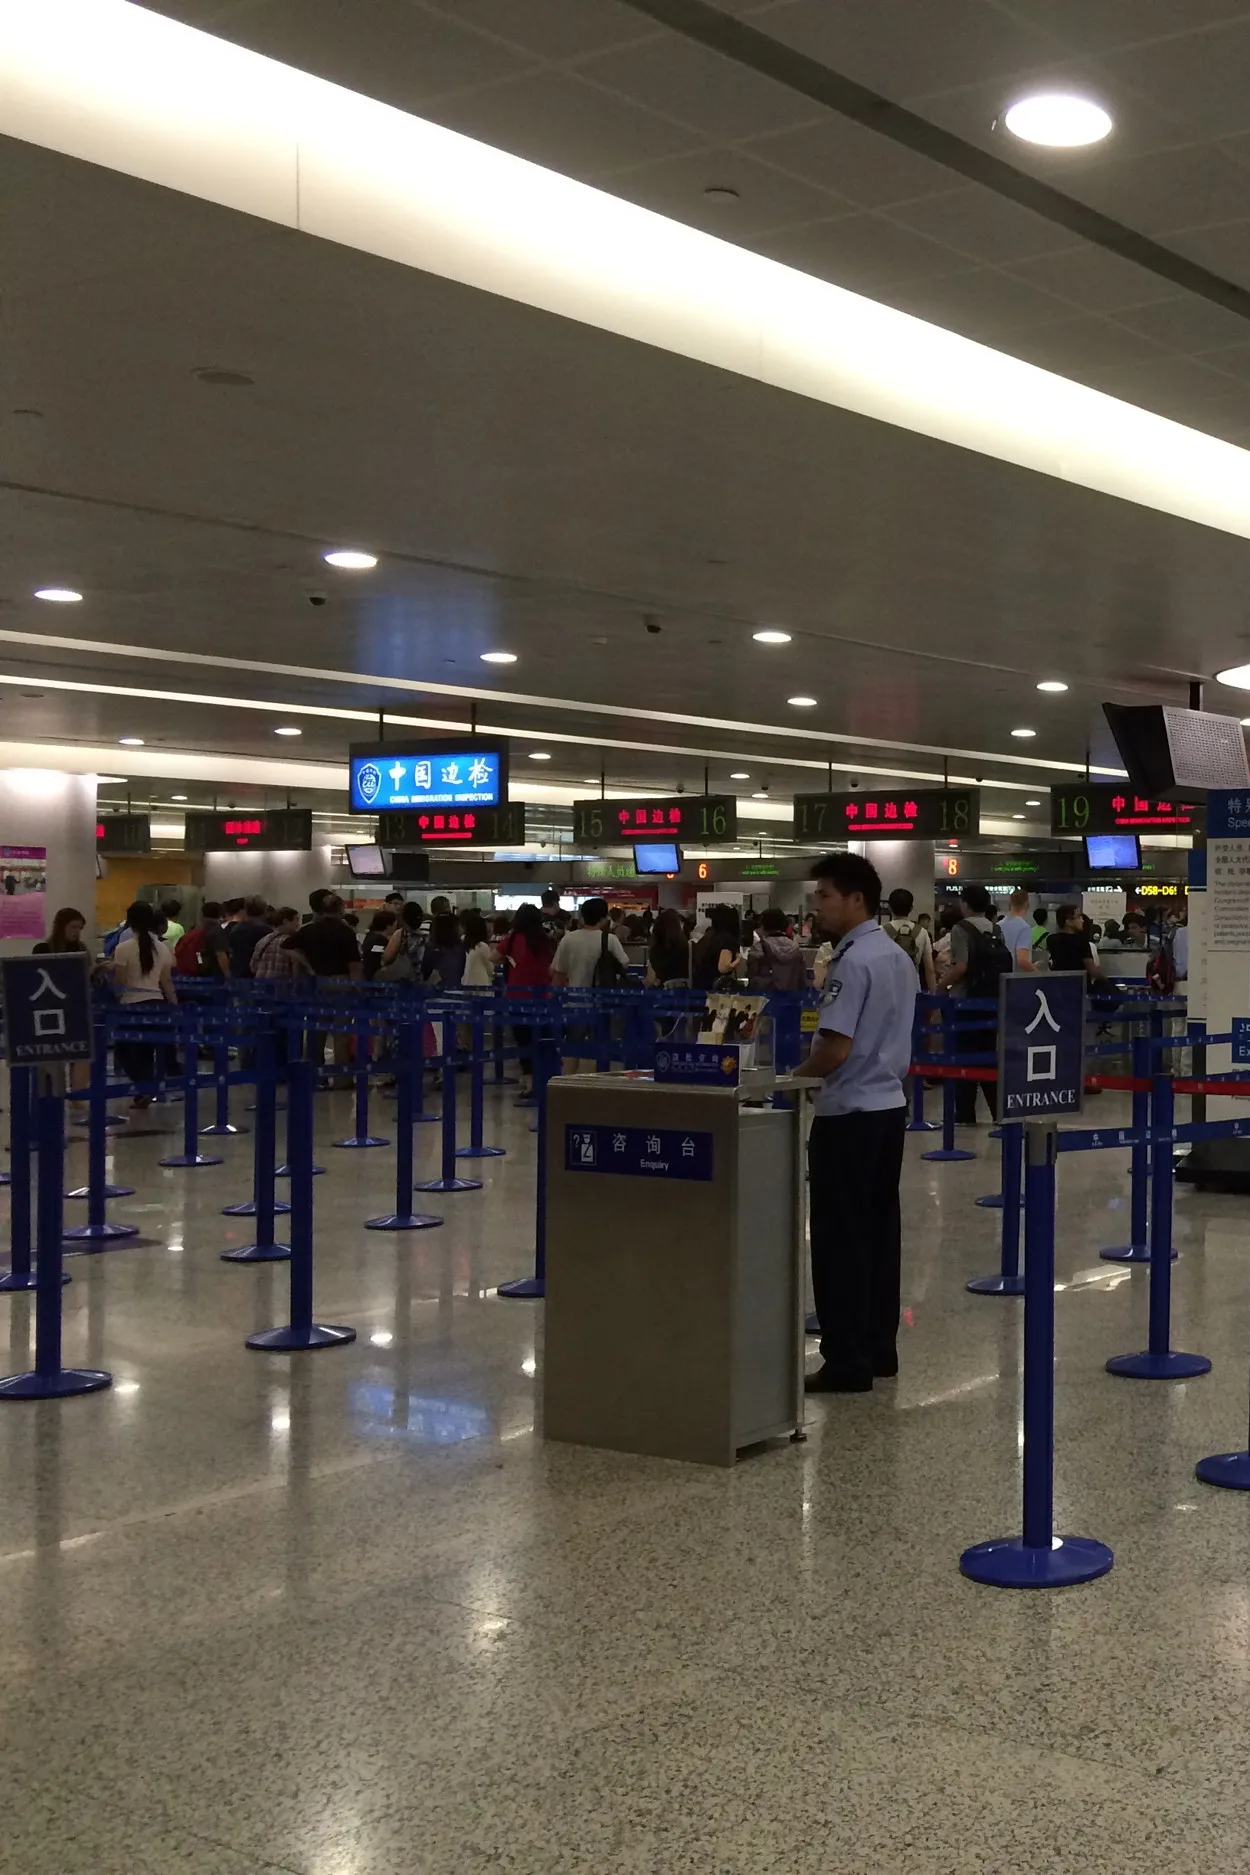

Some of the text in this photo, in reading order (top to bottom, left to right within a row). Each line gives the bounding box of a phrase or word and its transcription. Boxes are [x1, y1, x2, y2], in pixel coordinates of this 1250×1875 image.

[388, 757, 494, 791] 中国边检
[618, 808, 682, 825] 中国边检
[700, 805, 727, 835] 16
[800, 803, 828, 833] 17
[844, 800, 919, 819] 中国边检
[940, 799, 969, 831] 18
[1058, 796, 1090, 828] 19
[579, 810, 603, 837] 15
[698, 864, 707, 878] 6
[948, 858, 958, 875] 8
[28, 967, 67, 1036] 入口
[1024, 988, 1061, 1082] 入口
[16, 1041, 88, 1057] ENTRANCE
[1007, 1089, 1076, 1109] ENTRANCE
[612, 1132, 696, 1157] 咨询台
[640, 1158, 670, 1171] Enquiry
